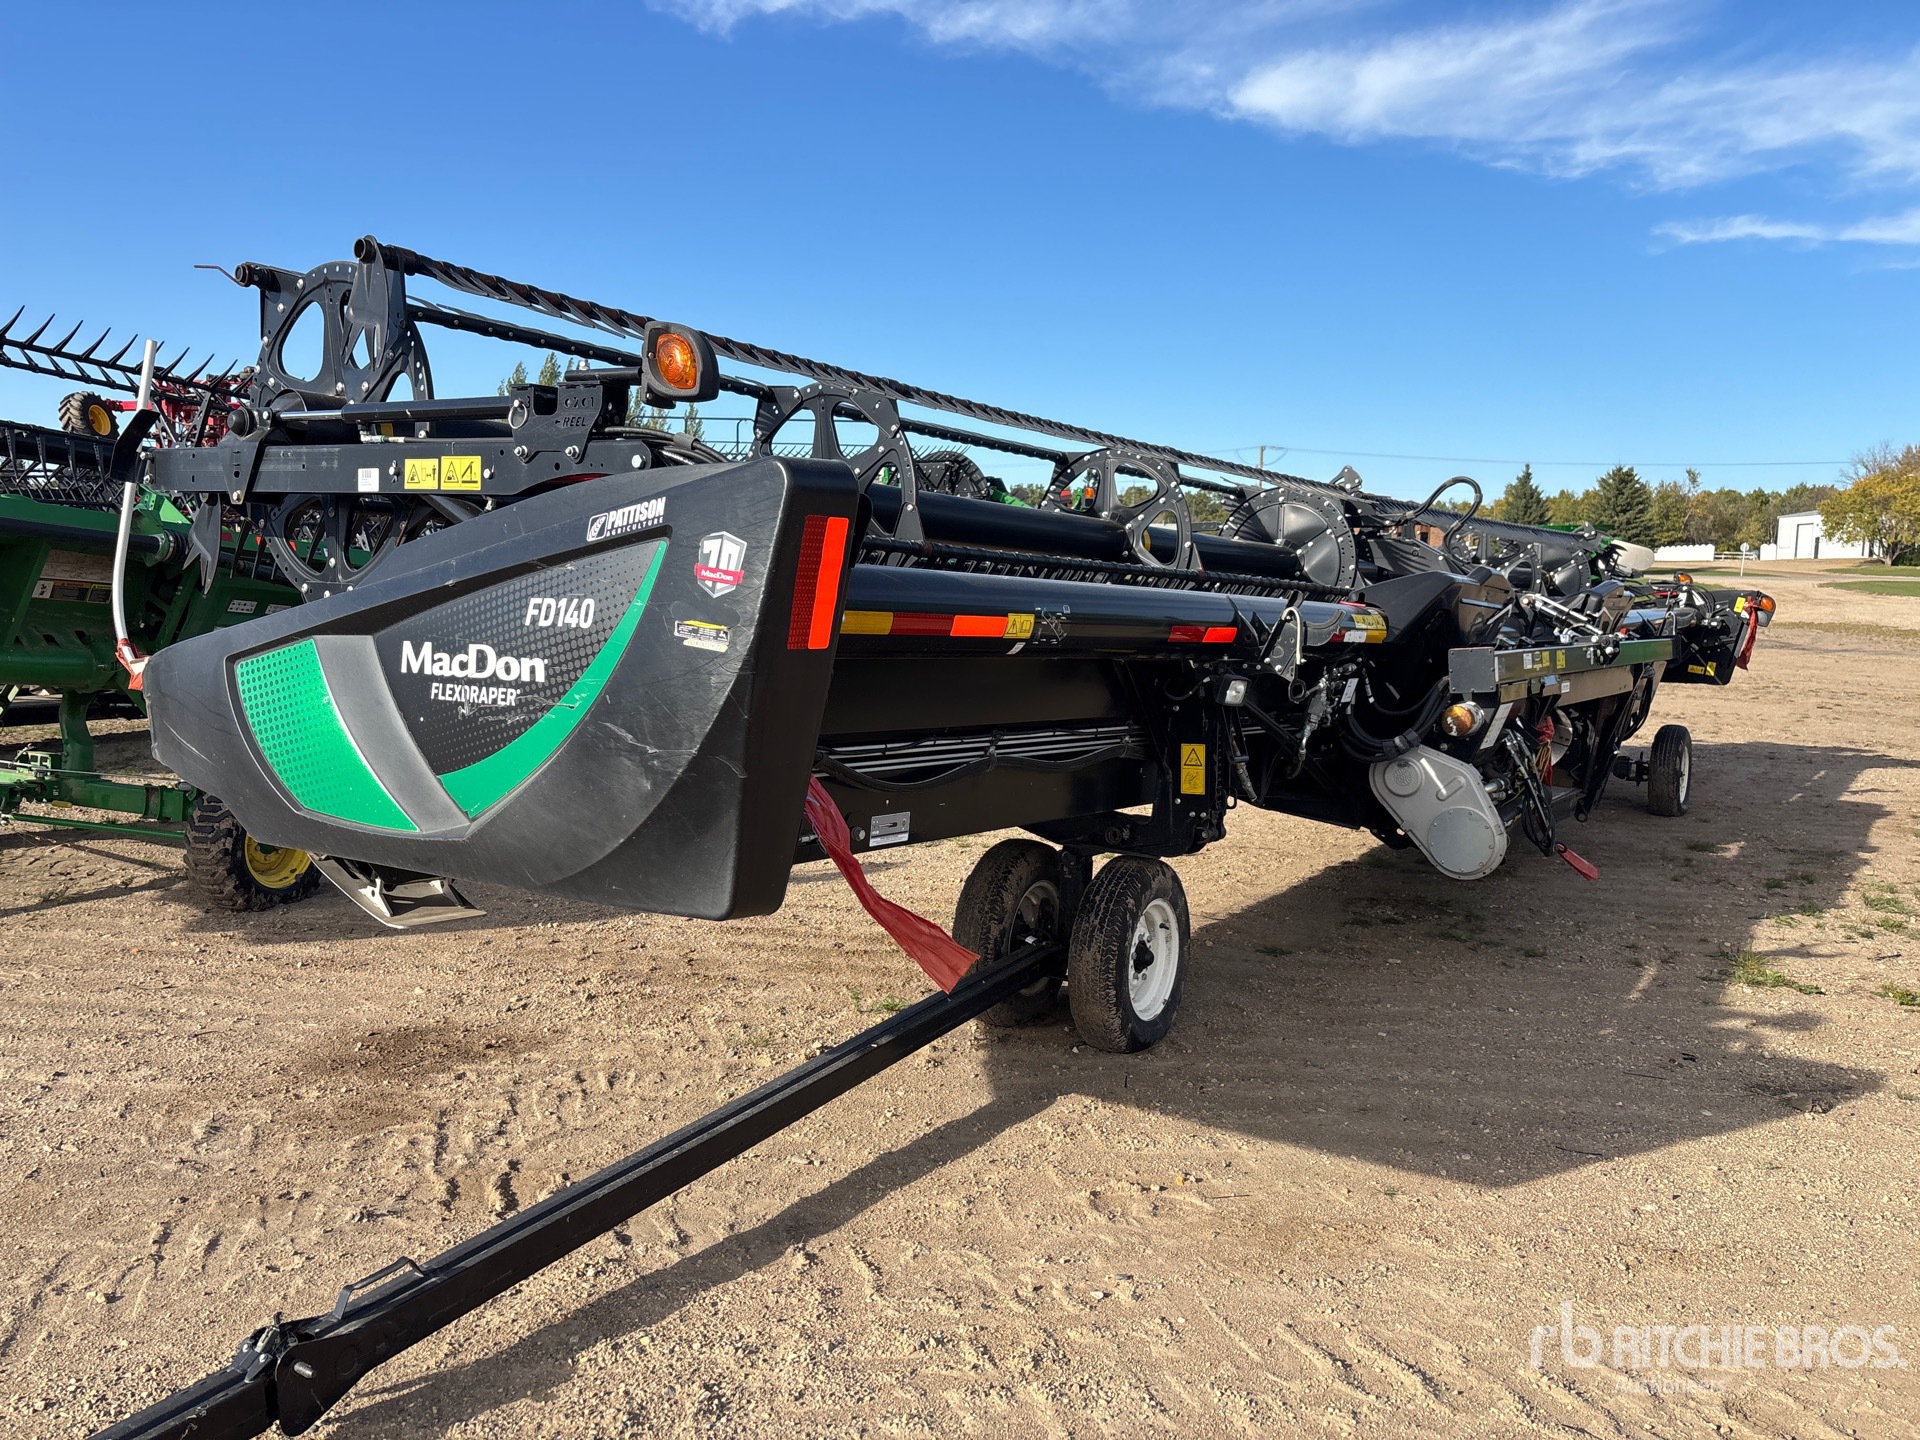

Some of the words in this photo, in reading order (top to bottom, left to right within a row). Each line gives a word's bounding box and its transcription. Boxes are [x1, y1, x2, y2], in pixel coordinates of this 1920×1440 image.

[562, 416, 586, 427] REEL
[606, 496, 667, 530] PATTISON
[605, 516, 664, 537] AGRICULTURE
[701, 569, 734, 581] MacDon
[525, 598, 595, 629] FD140
[401, 640, 545, 683] MacDon
[430, 682, 518, 706] FLEXDRAPER
